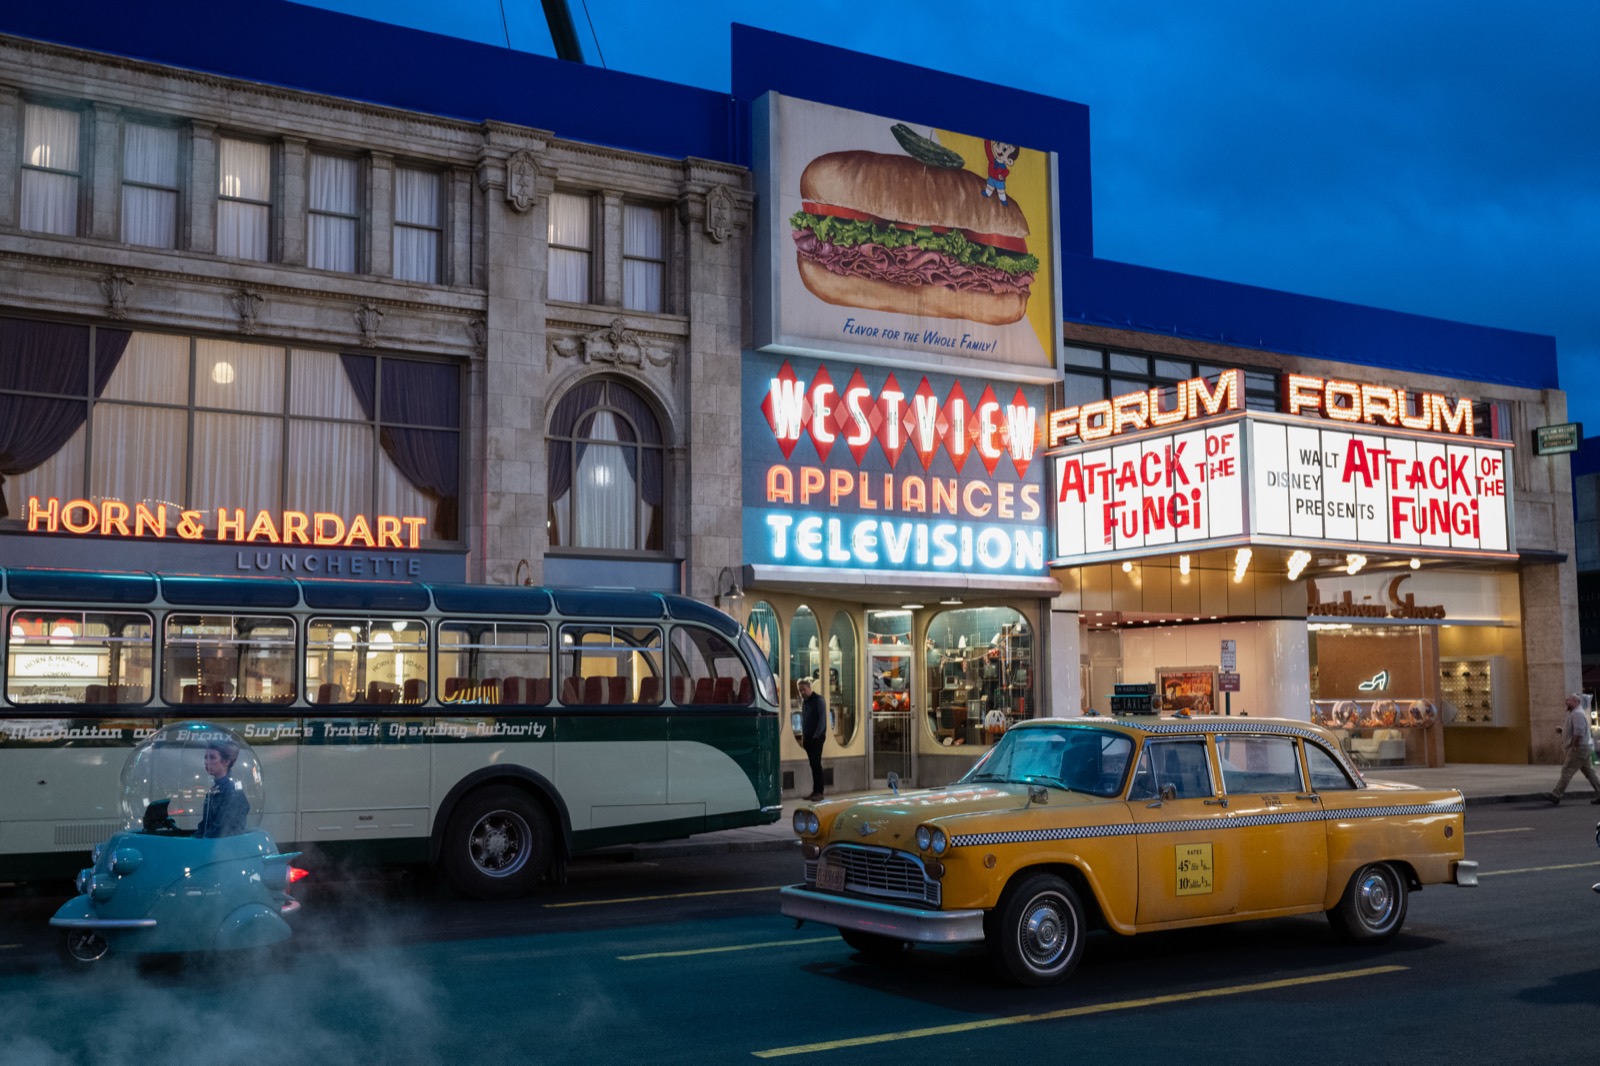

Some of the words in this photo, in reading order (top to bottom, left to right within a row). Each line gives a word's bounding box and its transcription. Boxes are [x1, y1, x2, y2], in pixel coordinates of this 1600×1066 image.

[1049, 369, 1241, 447] FORUM
[1288, 373, 1474, 436] FORUM
[769, 377, 1036, 462] WESTVIEW
[1205, 433, 1235, 457] OF
[1195, 457, 1235, 483] THE
[1299, 448, 1339, 469] WALT
[1342, 439, 1471, 496] ATTACK
[1481, 456, 1502, 477] OF
[1059, 441, 1189, 503] ATTACK
[1267, 470, 1321, 491] DISNEY
[767, 464, 1041, 521] APPLIANCES
[1475, 476, 1505, 497] THE
[28, 495, 168, 538] HORN
[176, 510, 205, 540] &
[217, 508, 427, 549] HARDART
[1296, 498, 1374, 520] PRESENTS
[766, 514, 1043, 570] TELEVISION
[237, 551, 421, 577] LUNCHETTE
[1122, 698, 1141, 709] TAXI
[8, 725, 122, 740] Manhattan
[133, 728, 167, 741] and
[176, 729, 237, 741] Bronx
[244, 724, 313, 741] Surface
[323, 723, 379, 737] Transit
[389, 723, 467, 739] Operating
[476, 722, 546, 737] Authority
